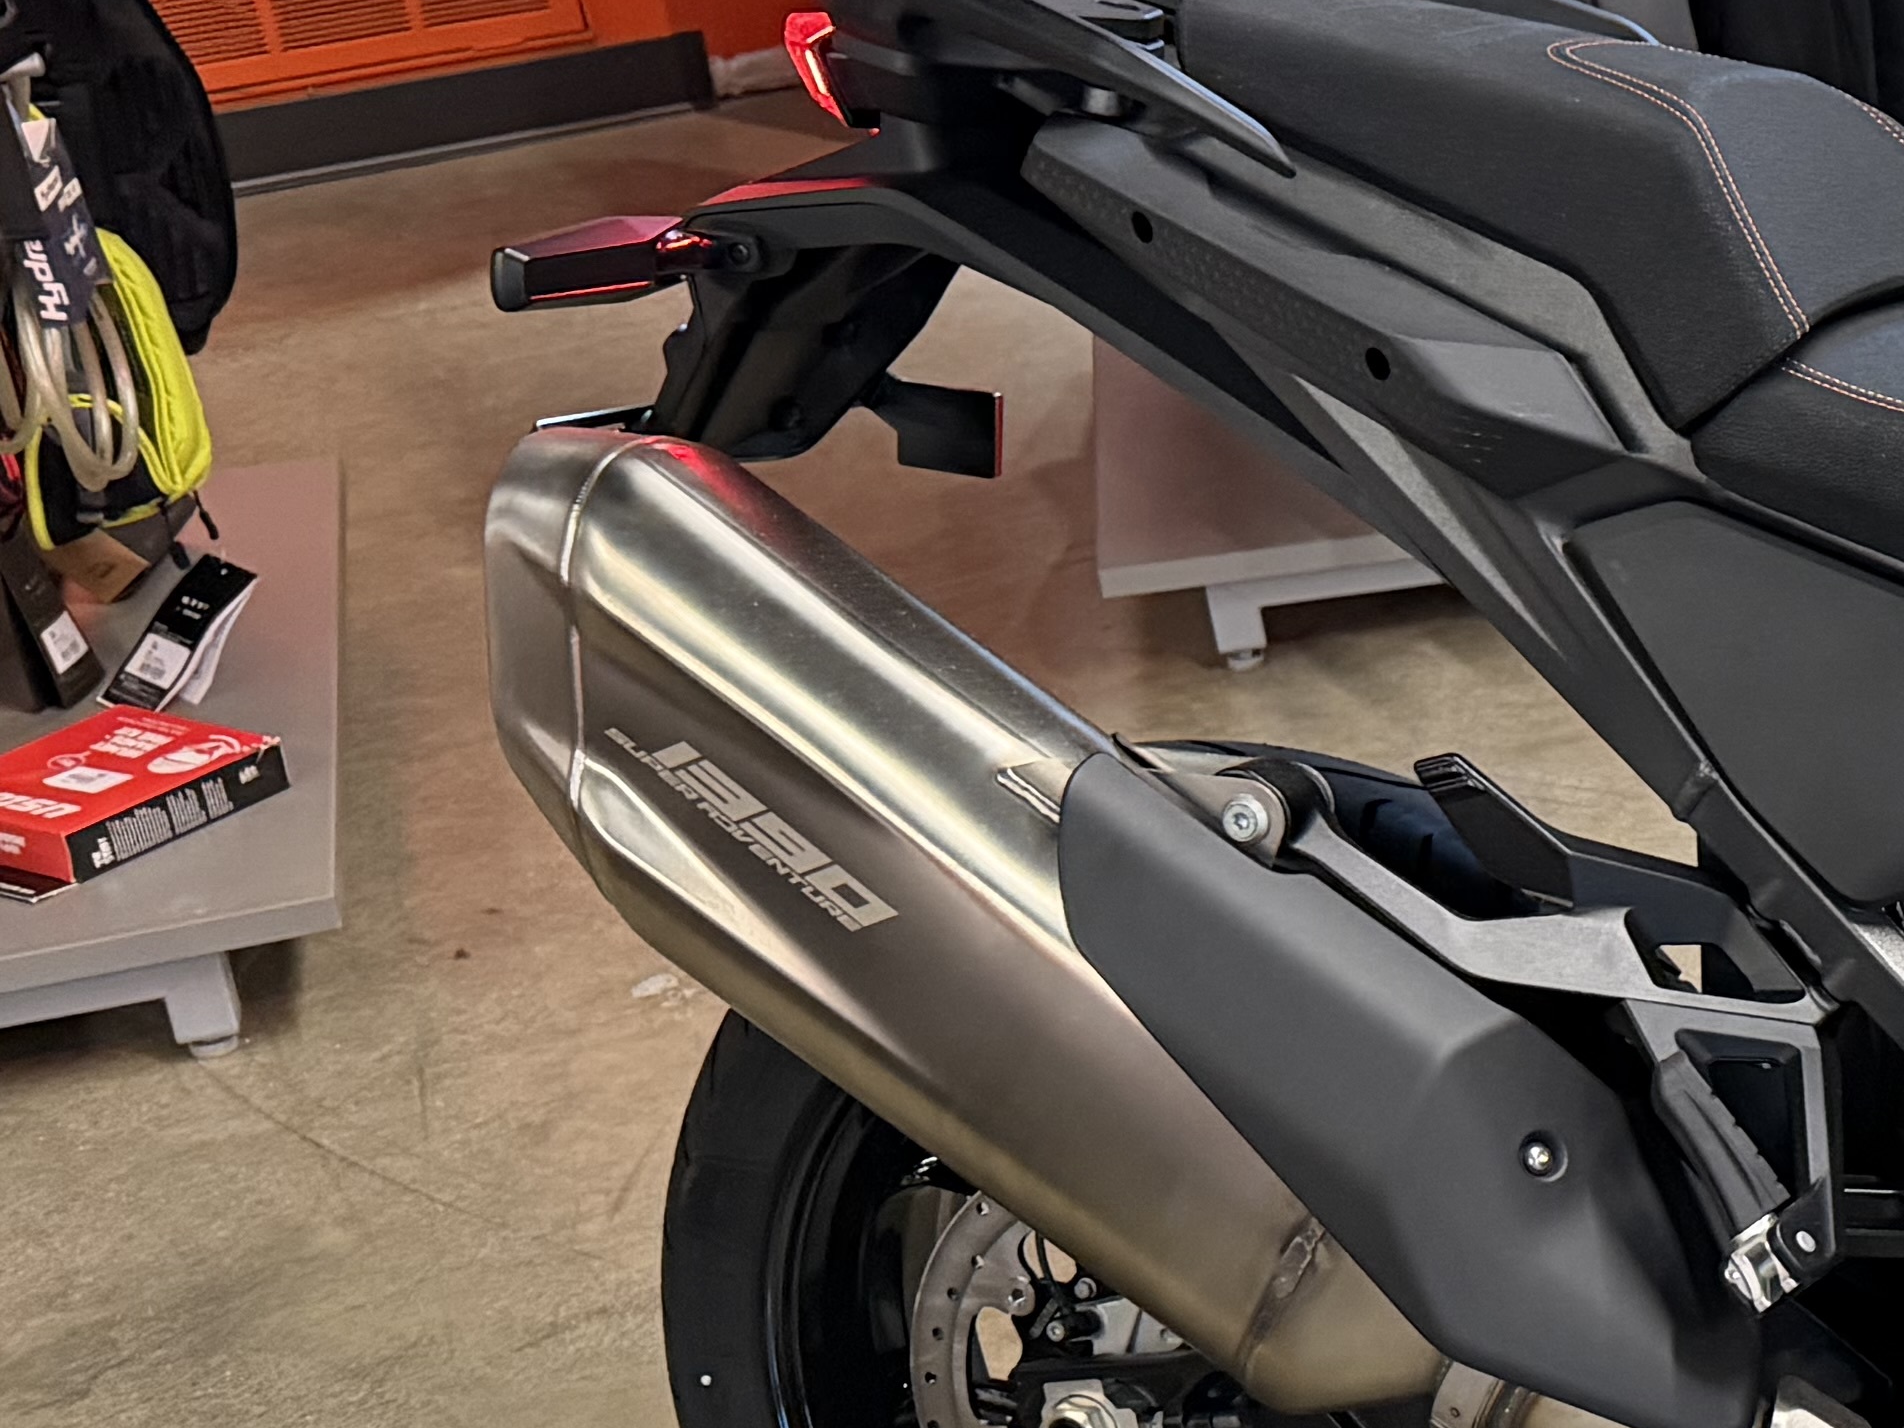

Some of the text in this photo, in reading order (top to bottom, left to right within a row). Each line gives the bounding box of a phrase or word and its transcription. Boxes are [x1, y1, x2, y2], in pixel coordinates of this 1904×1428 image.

[603, 727, 862, 933] SUPER ADVENTURE
[651, 740, 899, 928] 1390
